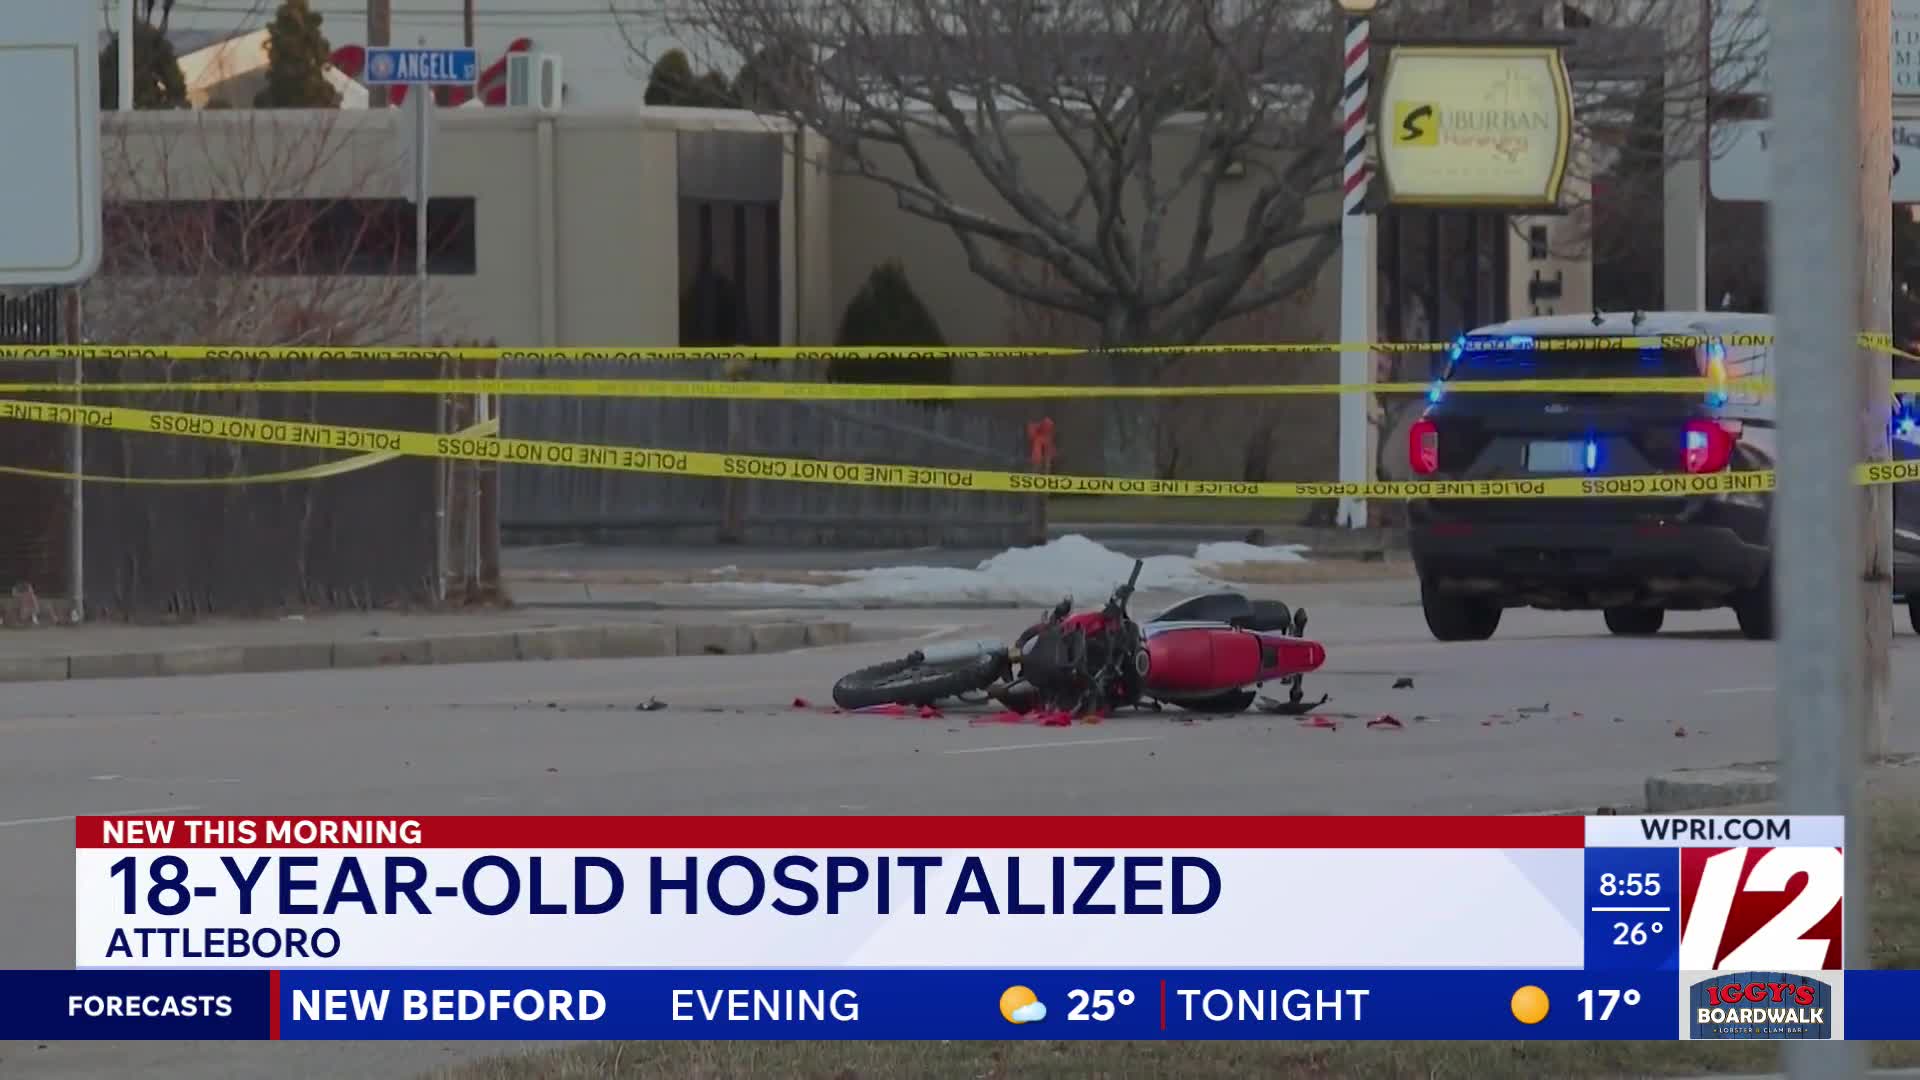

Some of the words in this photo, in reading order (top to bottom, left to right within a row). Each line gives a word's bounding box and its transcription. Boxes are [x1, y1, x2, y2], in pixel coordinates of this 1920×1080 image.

[398, 52, 457, 78] ANGELL
[3, 403, 42, 420] LINE
[49, 406, 113, 426] POLICE
[151, 414, 214, 435] CROSS
[219, 421, 256, 439] NOT
[261, 423, 286, 440] DO
[292, 426, 331, 444] LINE
[336, 430, 400, 450] POLICE
[438, 438, 500, 459] CROSS
[504, 443, 542, 461] NOT
[547, 445, 573, 463] DO
[579, 448, 618, 466] LINE
[623, 450, 688, 471] POLICE
[724, 457, 787, 477] CROSS
[793, 462, 828, 479] NOT
[833, 464, 859, 480] DO
[864, 468, 903, 484] LINE
[908, 469, 973, 487] POLICE
[1869, 463, 1920, 481] ROSS
[1009, 475, 1072, 491] CROSS
[1078, 478, 1114, 491] NOT
[1119, 479, 1145, 492] DO
[1195, 481, 1259, 494] POLICE
[1295, 482, 1358, 495] CROSS
[1363, 482, 1400, 495] NOT
[1404, 482, 1431, 495] DO
[1437, 482, 1475, 495] LINE
[1480, 481, 1545, 495] POLICE
[1582, 477, 1643, 494] CROSS
[1650, 476, 1686, 492] NOT
[1691, 475, 1718, 491] DO
[1722, 473, 1762, 490] LINE
